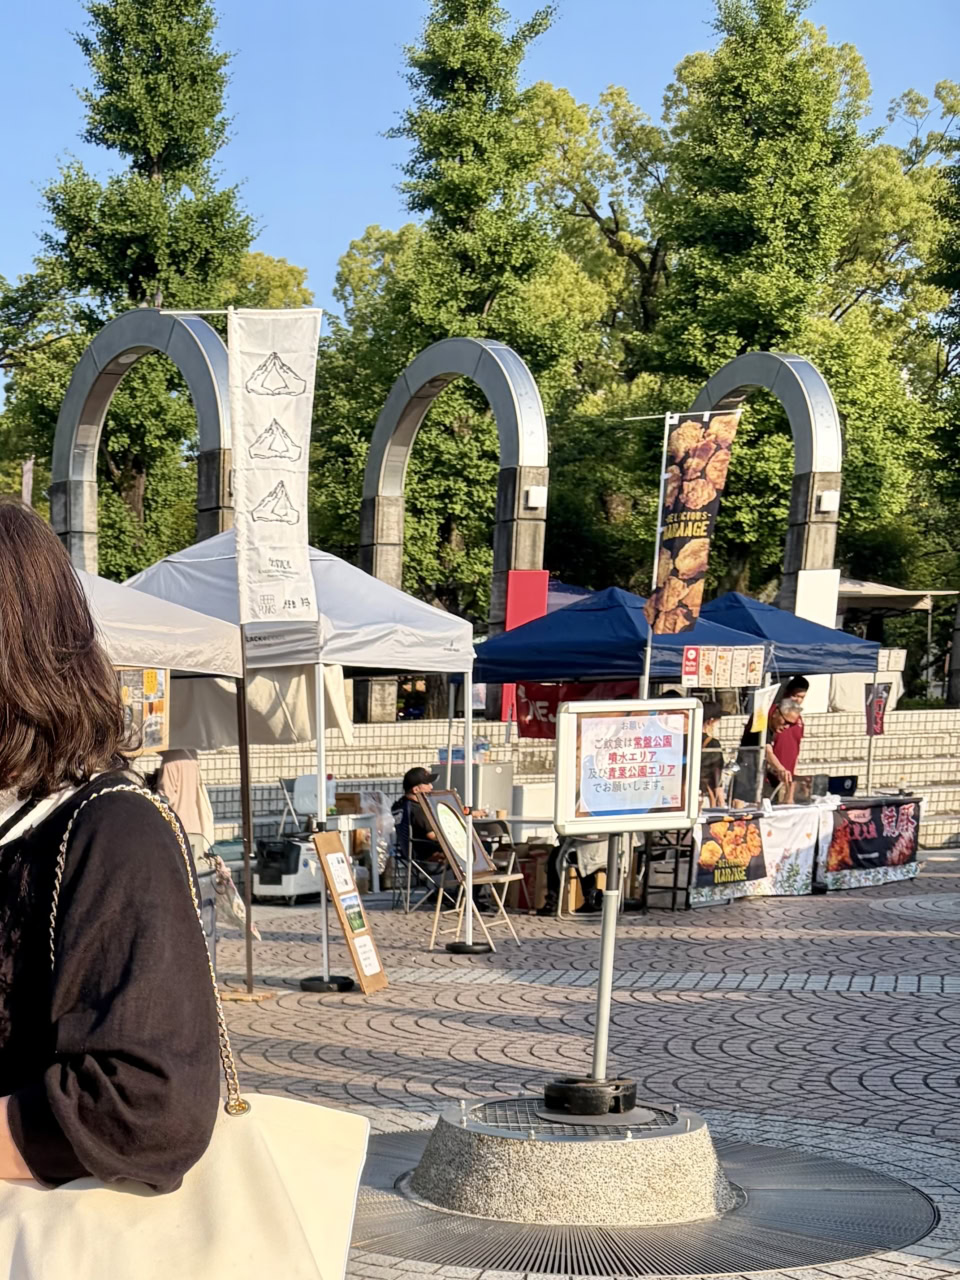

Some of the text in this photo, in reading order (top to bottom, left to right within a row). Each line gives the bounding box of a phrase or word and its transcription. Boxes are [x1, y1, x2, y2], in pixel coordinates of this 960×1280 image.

[621, 720, 646, 730] お願い
[594, 735, 672, 749] ご飲食は常盤公園
[608, 751, 657, 765] 噴水エリア
[588, 765, 676, 779] 及び青葉公園エリア
[593, 780, 665, 793] でお願いします。
